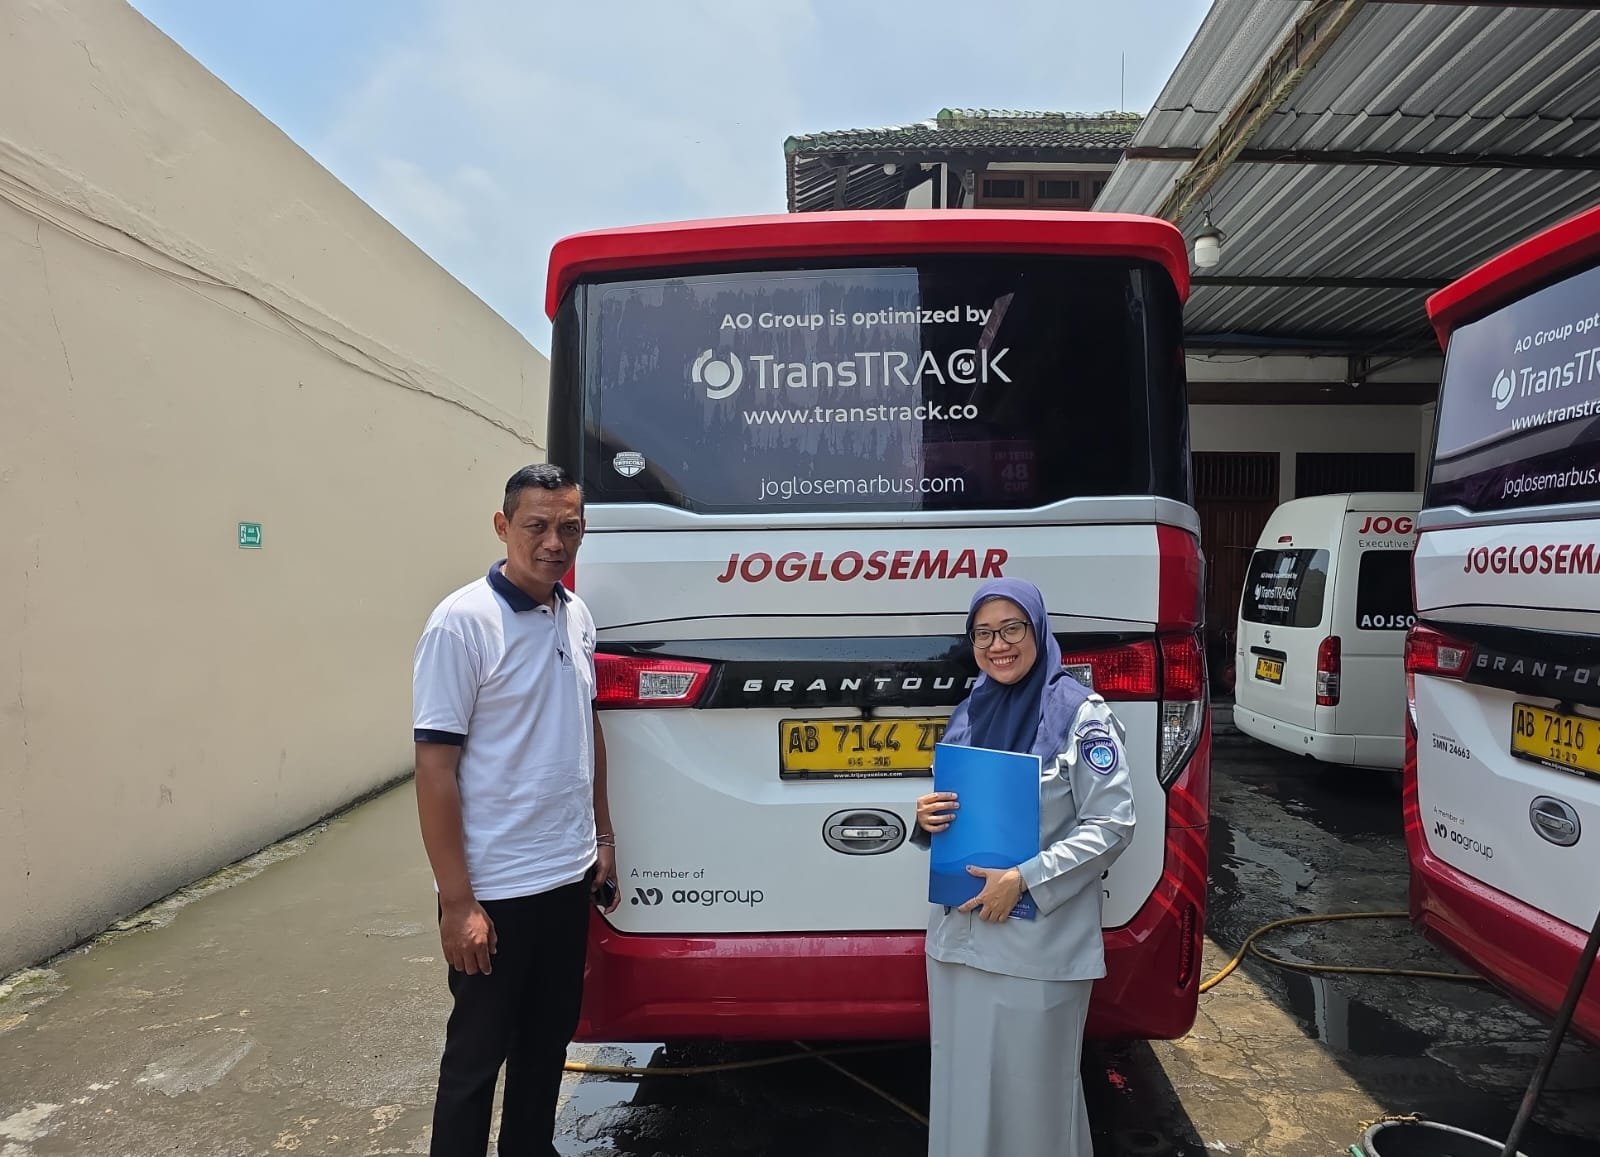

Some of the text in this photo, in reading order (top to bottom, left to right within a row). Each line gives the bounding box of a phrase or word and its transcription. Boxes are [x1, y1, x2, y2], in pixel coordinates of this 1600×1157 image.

[720, 305, 993, 330] AO Group is optimized by
[1514, 336, 1532, 354] AO
[1535, 324, 1573, 346] Group
[750, 347, 1013, 389] TransTRACK
[743, 401, 978, 425] www.transtrack.co
[758, 475, 965, 500] joglosemarbus.com
[1359, 516, 1417, 534] JOG
[1359, 540, 1409, 548] Executive
[717, 548, 1008, 583] JOGLOSEMAR
[1476, 654, 1600, 686] GRANTO
[789, 725, 820, 753] AB
[833, 723, 900, 752] 7144
[1517, 710, 1535, 737] AB
[1544, 715, 1584, 750] 7116
[1433, 738, 1470, 760] SMN 24663
[1450, 830, 1494, 861] aogroup
[630, 868, 705, 879] A member of
[671, 889, 764, 907] aogroup
